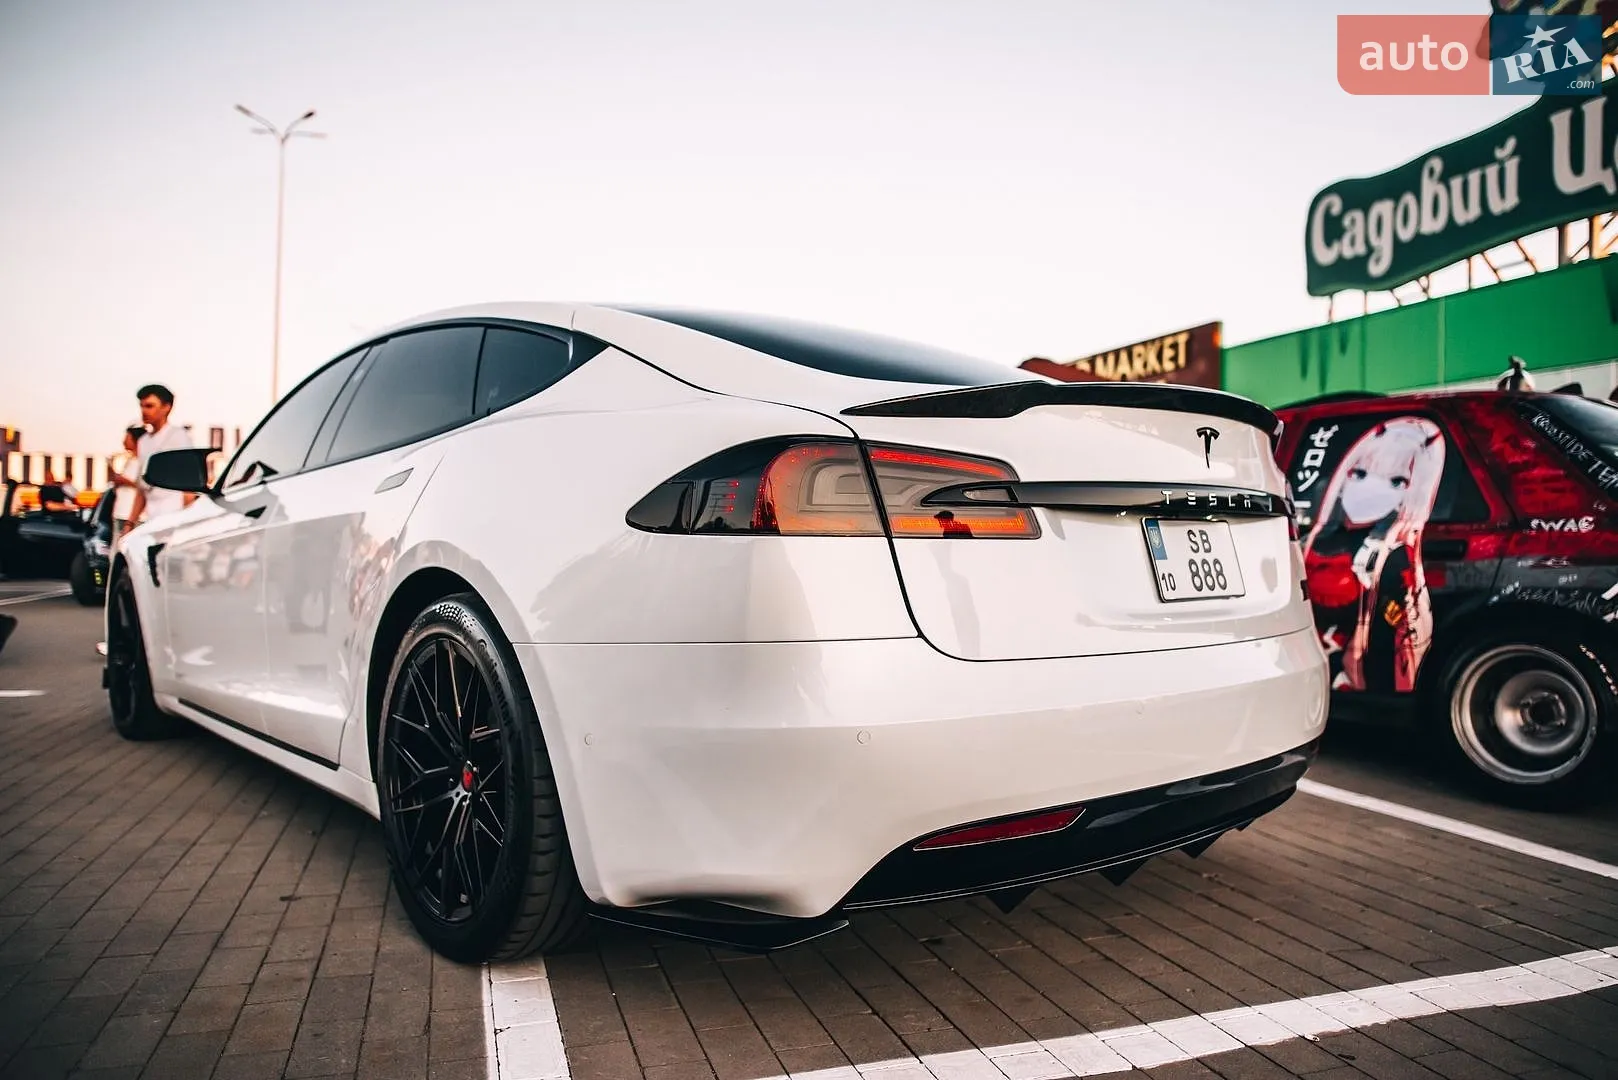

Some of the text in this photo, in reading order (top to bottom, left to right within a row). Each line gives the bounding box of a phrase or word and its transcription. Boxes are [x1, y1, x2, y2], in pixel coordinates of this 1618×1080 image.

[1311, 97, 1618, 278] Садовий Ц
[1094, 331, 1190, 382] MARKET
[1161, 490, 1251, 508] TESLA
[1187, 529, 1212, 554] SB
[1161, 558, 1228, 592] 10 888
